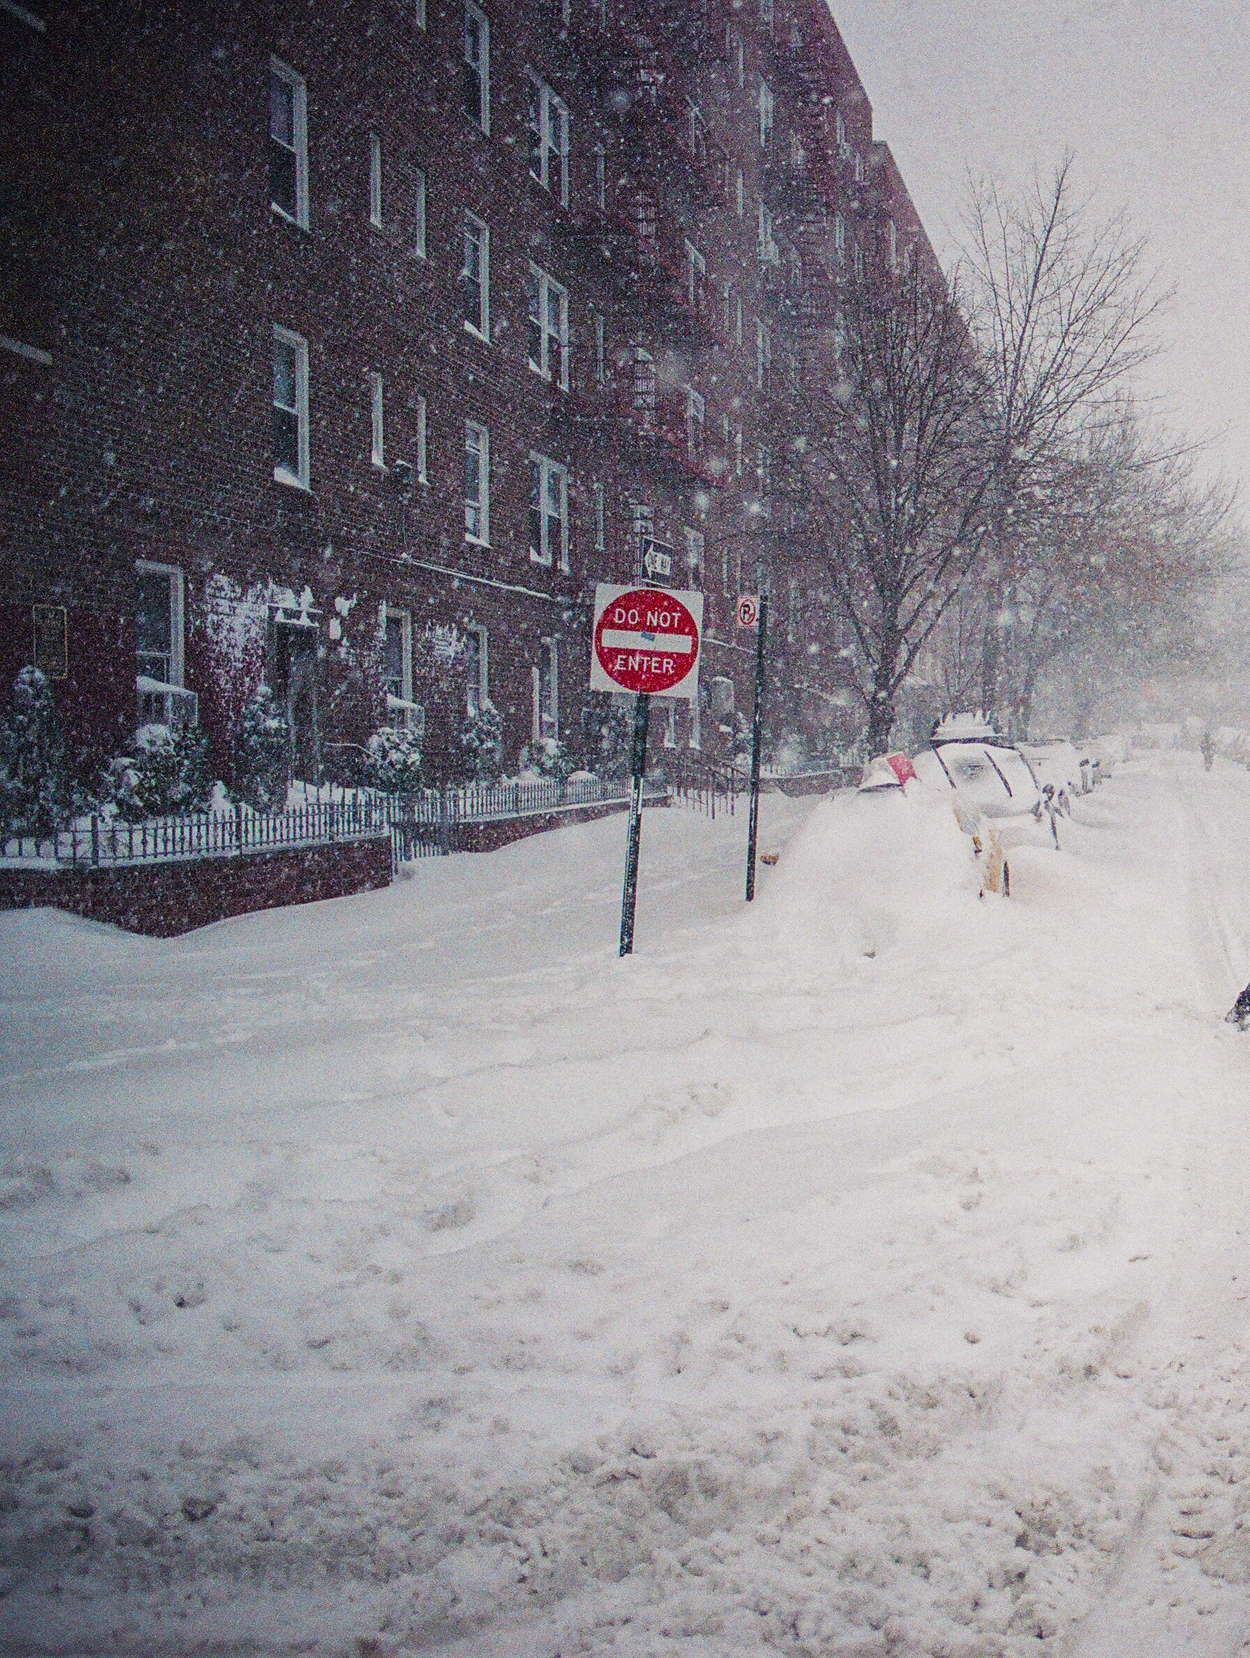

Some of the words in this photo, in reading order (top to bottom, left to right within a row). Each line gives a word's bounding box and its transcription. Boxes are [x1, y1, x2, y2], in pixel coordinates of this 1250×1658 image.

[614, 608, 638, 625] DO
[646, 610, 681, 628] NOT
[617, 654, 674, 674] ENTER
